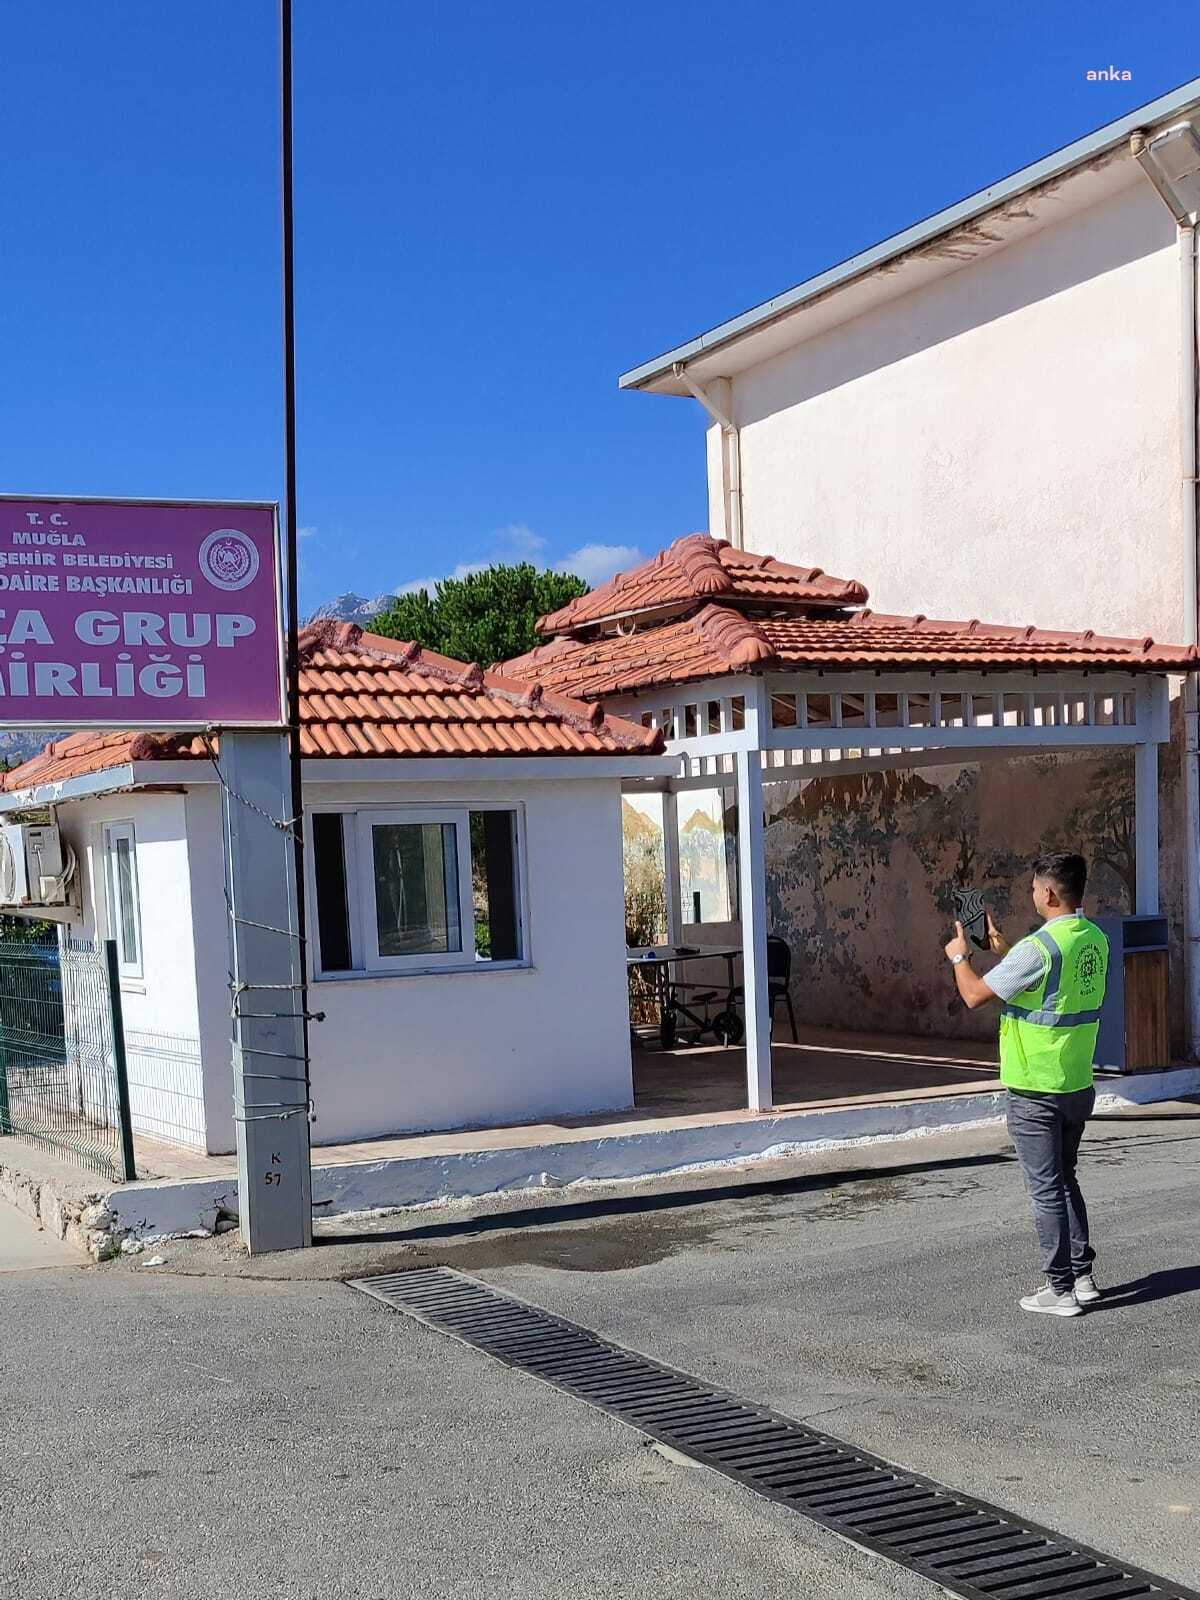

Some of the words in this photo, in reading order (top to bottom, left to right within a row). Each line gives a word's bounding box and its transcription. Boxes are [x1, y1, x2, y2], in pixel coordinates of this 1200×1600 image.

[26, 512, 44, 525] T.
[49, 513, 69, 526] C.
[12, 529, 87, 547] MUĞLA
[62, 552, 173, 569] BELEDİYESİ
[66, 573, 193, 598] BAŞKANLIĞI
[74, 610, 257, 648] GRUP
[0, 651, 206, 698] İRLİĞİ
[271, 1152, 281, 1164] K
[265, 1172, 281, 1186] 57
